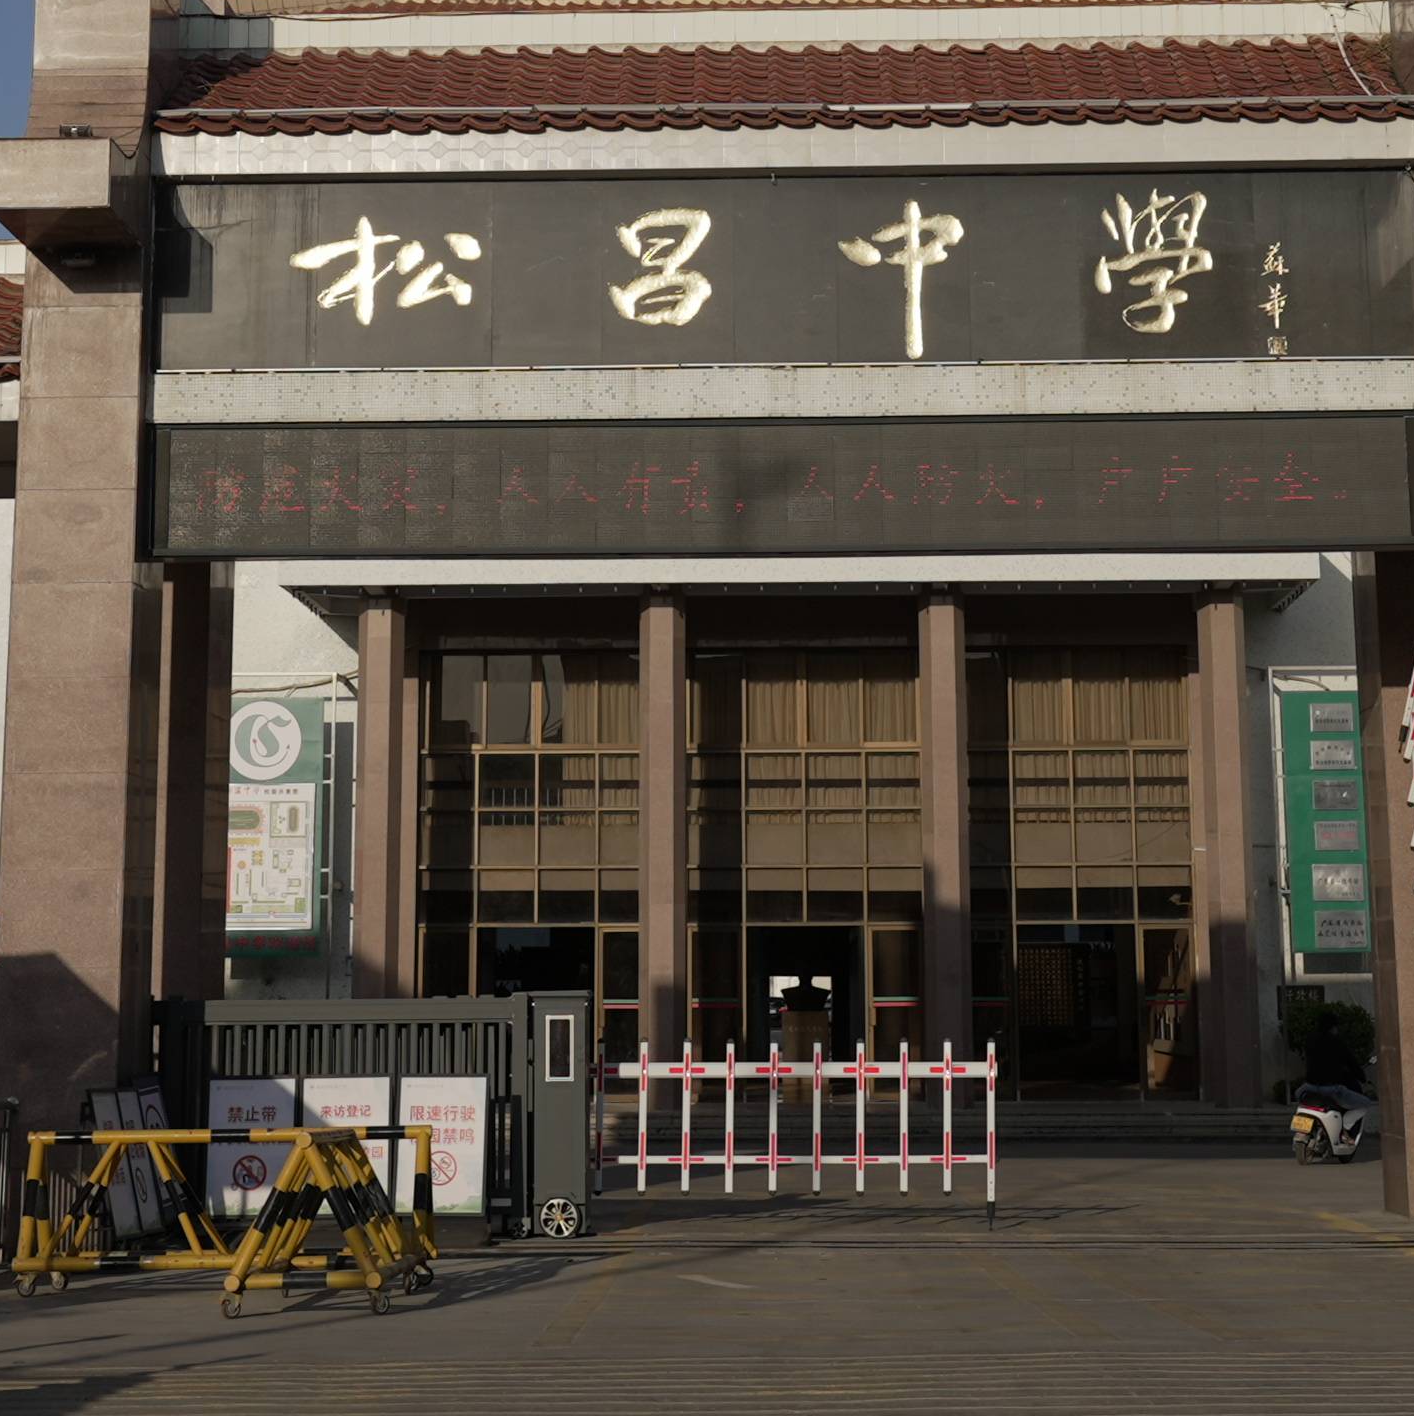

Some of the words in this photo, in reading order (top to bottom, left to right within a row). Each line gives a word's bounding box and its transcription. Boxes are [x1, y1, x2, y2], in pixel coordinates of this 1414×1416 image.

[227, 1105, 277, 1123] 禁止带
[320, 1104, 372, 1118] 来访登记
[410, 1105, 476, 1122] 限速行驶
[410, 1128, 475, 1145] 园禁鸣
